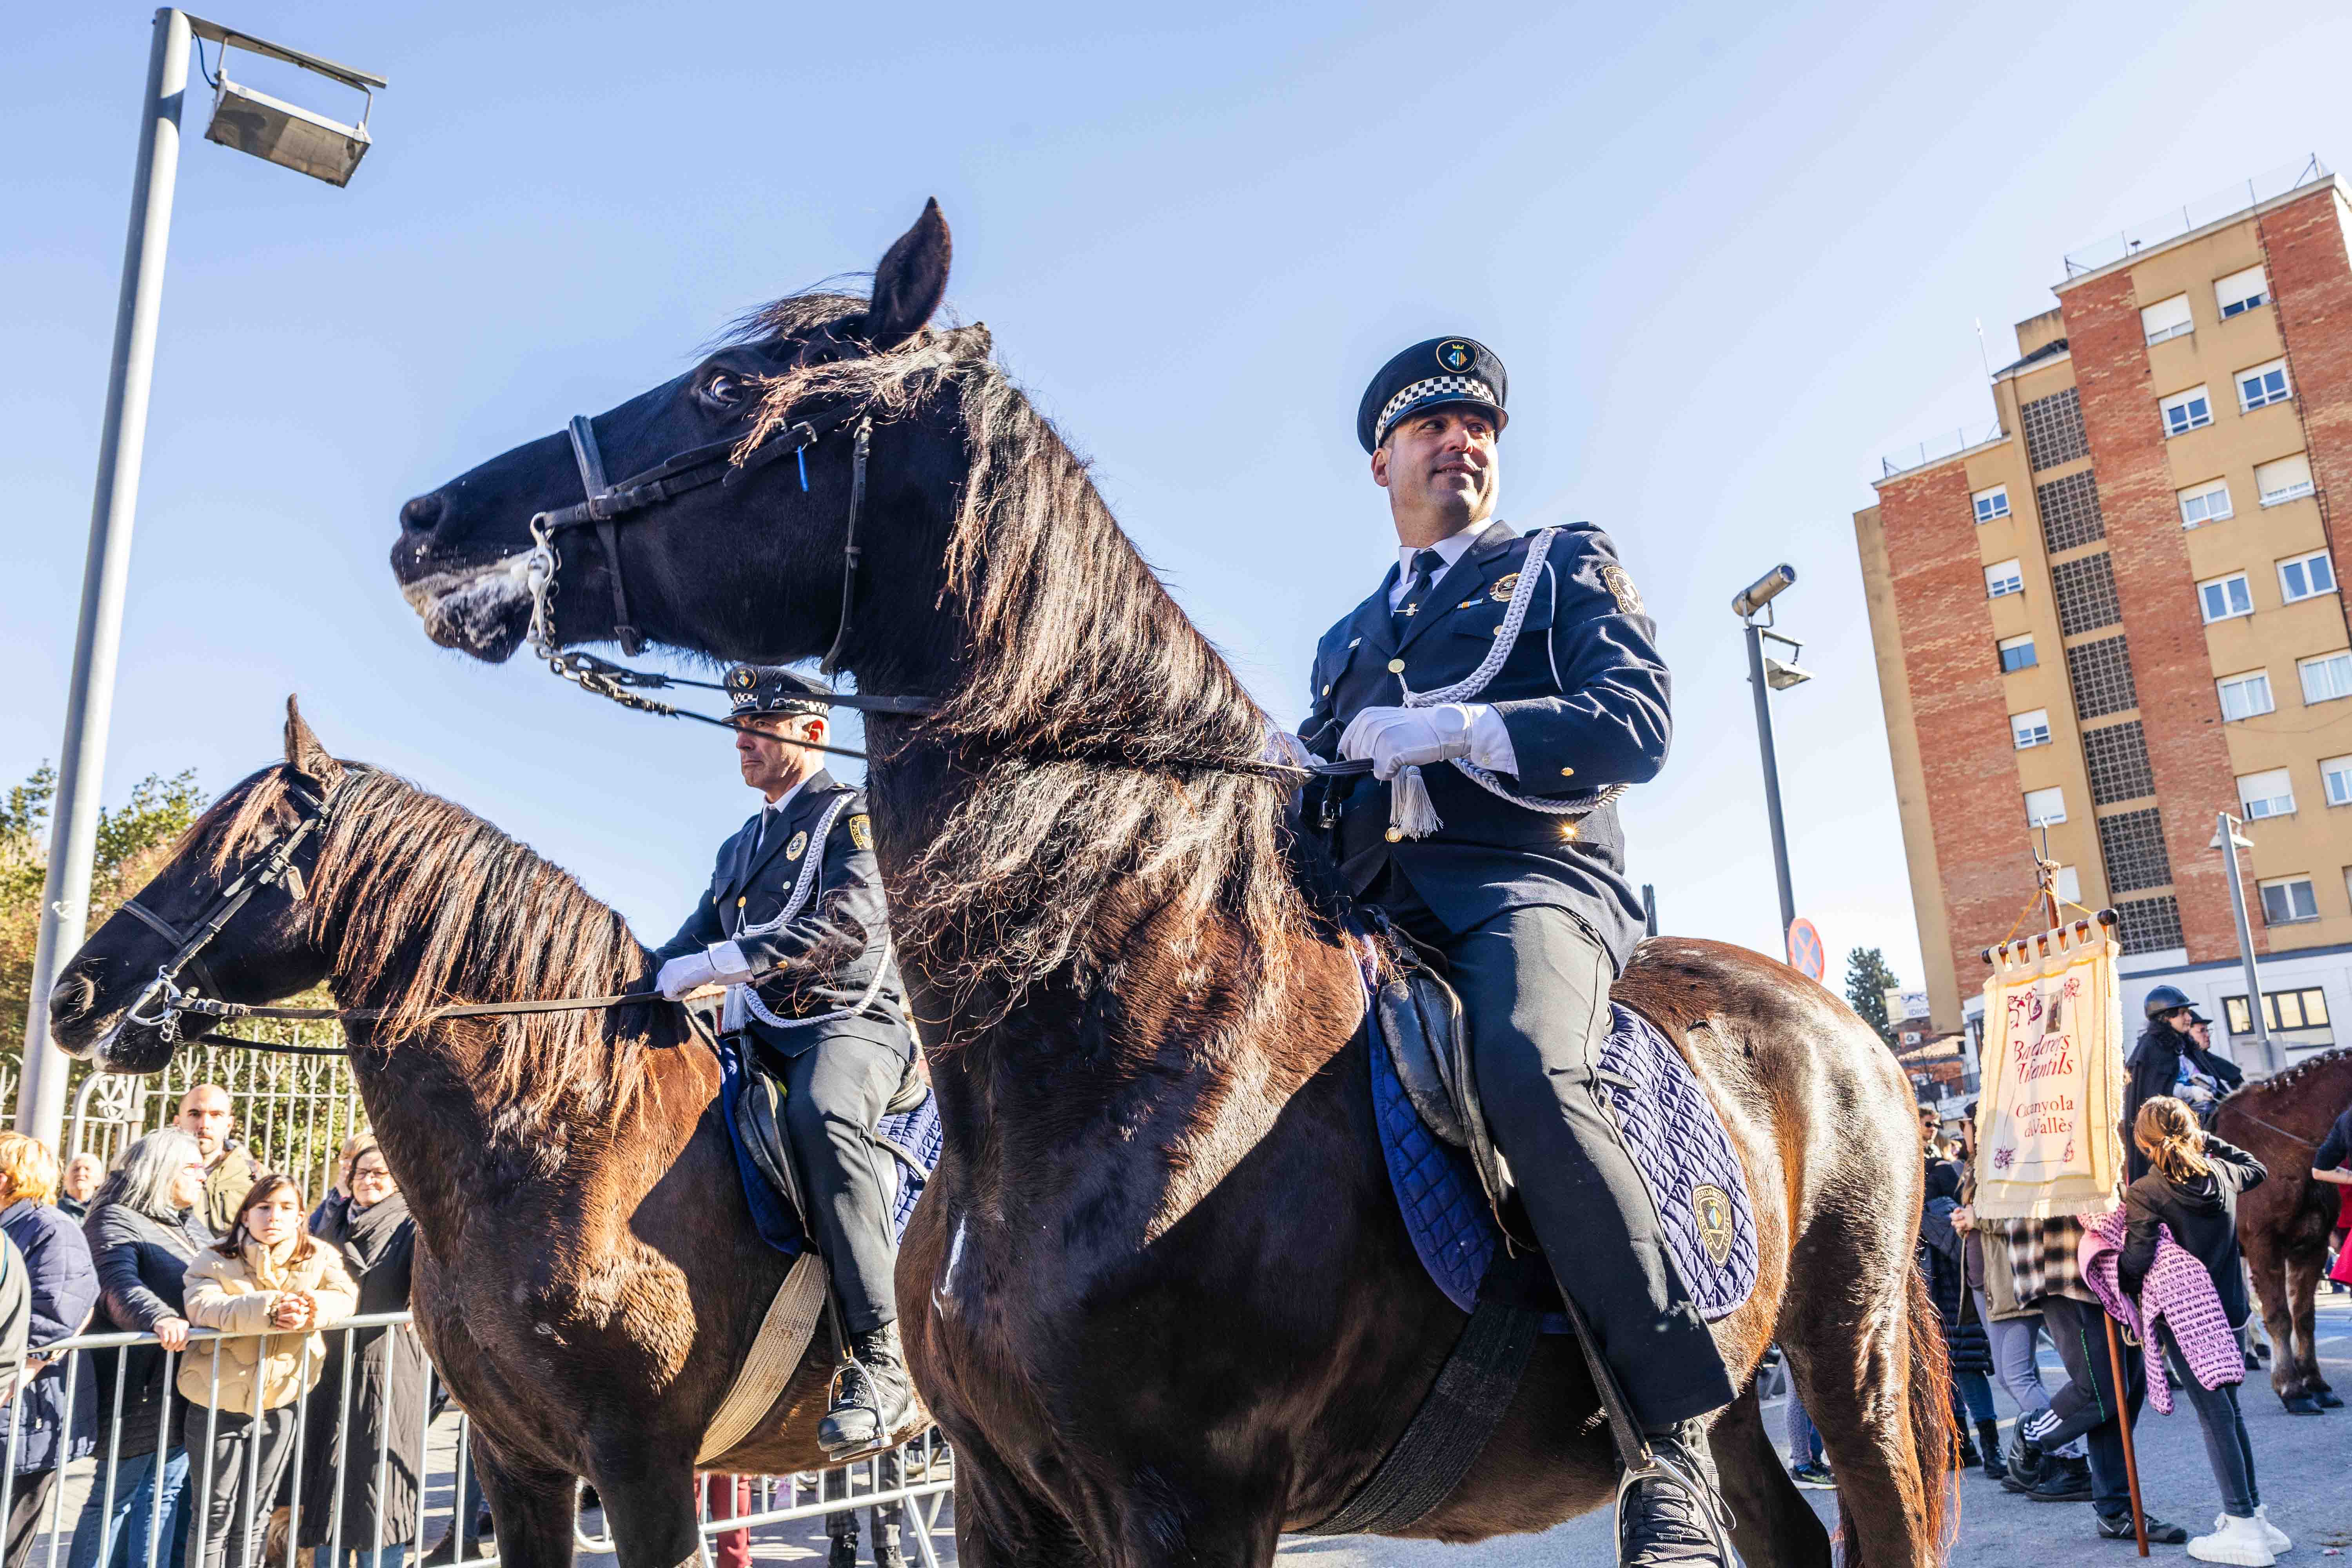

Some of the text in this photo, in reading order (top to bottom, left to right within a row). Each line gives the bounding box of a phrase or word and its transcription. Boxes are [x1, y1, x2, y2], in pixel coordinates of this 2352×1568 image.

[1610, 579, 1627, 608] POLICIA
[852, 825, 862, 846] POLICIA
[2033, 1116, 2073, 1134] Vallès
[1698, 1210, 1713, 1248] POLICIA
[2169, 1256, 2185, 1265] RUN
[2152, 1270, 2167, 1280] FUN
[2168, 1265, 2183, 1273] RUN
[2176, 1271, 2192, 1279] RUN
[2160, 1277, 2175, 1285] SUN
[2160, 1284, 2209, 1303] FUN RUN SUN
[2185, 1294, 2201, 1303] SUN
[2171, 1317, 2186, 1326] RUN
[2187, 1311, 2203, 1319] SUN
[2196, 1318, 2212, 1327] RUN
[2177, 1322, 2228, 1342] FUN RUN SUN
[2179, 1323, 2195, 1333] SUN
[2190, 1338, 2207, 1347] FUN
[2208, 1332, 2223, 1341] SUN
[2200, 1343, 2216, 1352] SUN
[2217, 1338, 2233, 1346] FUN
